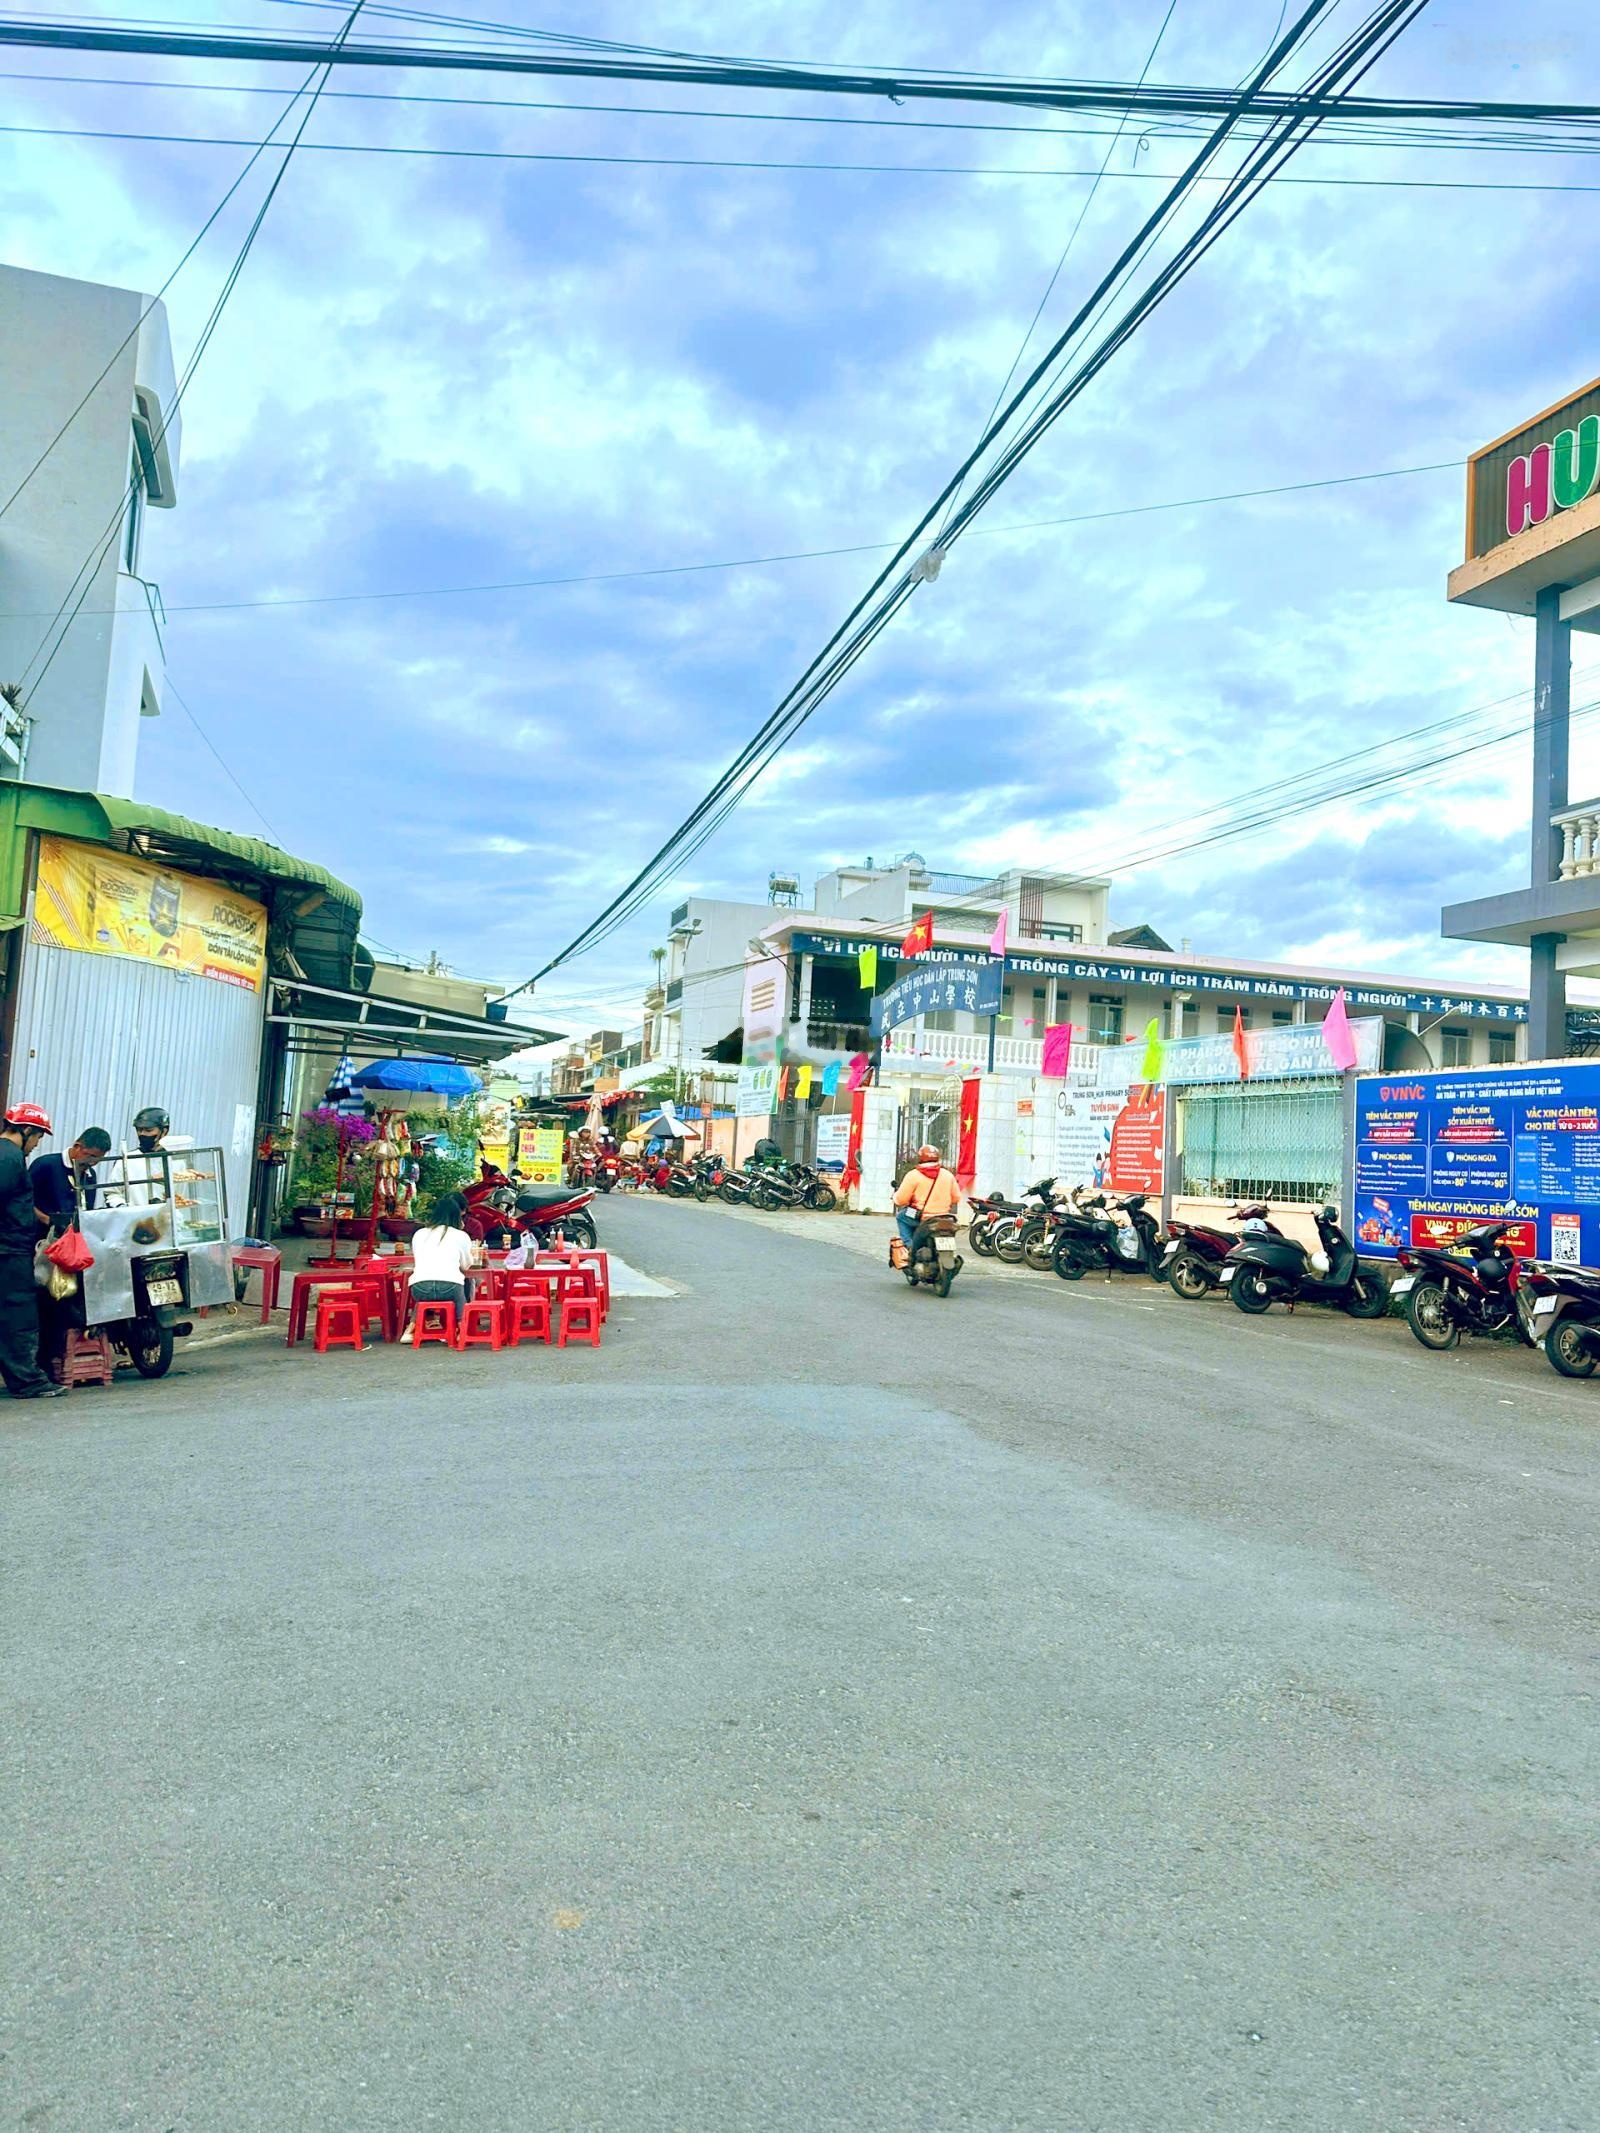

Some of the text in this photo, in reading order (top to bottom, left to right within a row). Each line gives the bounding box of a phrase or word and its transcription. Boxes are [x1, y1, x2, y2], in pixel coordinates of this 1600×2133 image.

[913, 974, 923, 990] HỌC
[924, 969, 935, 985] DÂN
[936, 967, 947, 984] LẬP
[948, 968, 965, 981] TRUNG
[966, 969, 979, 985] SƠN
[1010, 958, 1070, 975] TRỒNG
[1141, 970, 1164, 986] LỢI
[1170, 972, 1198, 987] ÍCH
[1202, 976, 1250, 992] TRĂM
[1254, 980, 1294, 996] NĂM
[1391, 1085, 1426, 1101] VNVC
[1526, 1105, 1597, 1119] VẮC XIN CẦN TIÊM
[1524, 1122, 1542, 1131] CHO
[1543, 1120, 1556, 1131] TRẺ
[1456, 1153, 1497, 1162] PHÒNG NGỪA
[1408, 1198, 1427, 1211] TIÊM
[1427, 1201, 1453, 1213] NGAY
[1453, 1201, 1488, 1214] PHÒNG
[1516, 1203, 1539, 1218] SỚM
